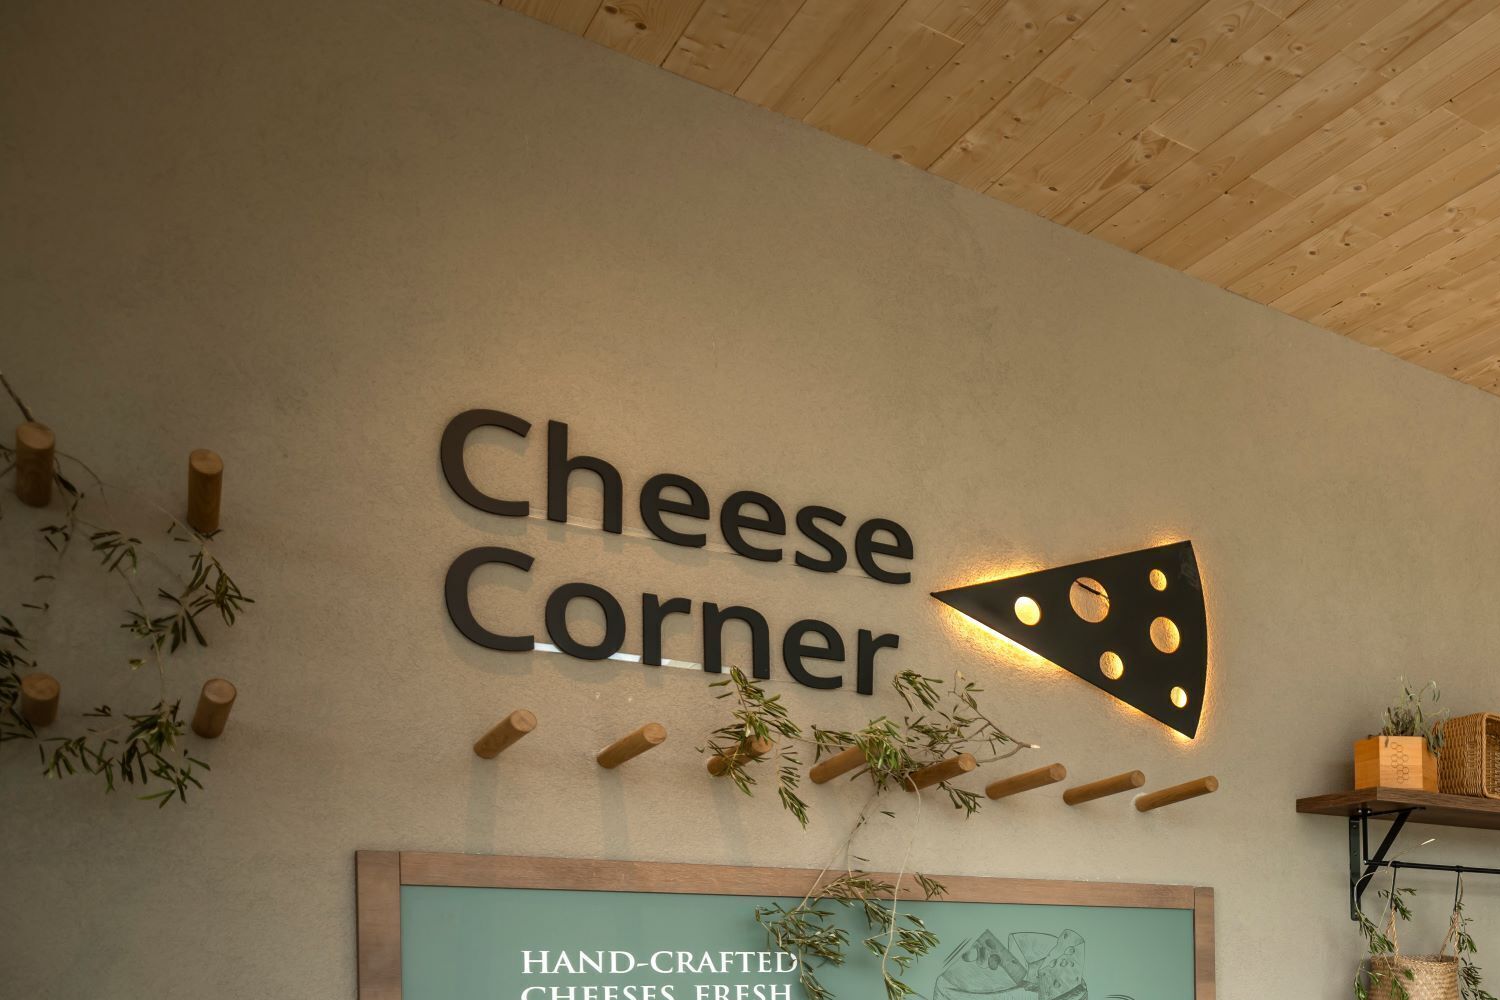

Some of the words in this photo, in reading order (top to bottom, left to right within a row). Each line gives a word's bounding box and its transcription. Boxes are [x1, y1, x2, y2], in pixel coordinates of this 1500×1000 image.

[440, 408, 914, 584] Cheese
[444, 546, 899, 695] Corner
[521, 950, 798, 975] HAND-CRAFTED
